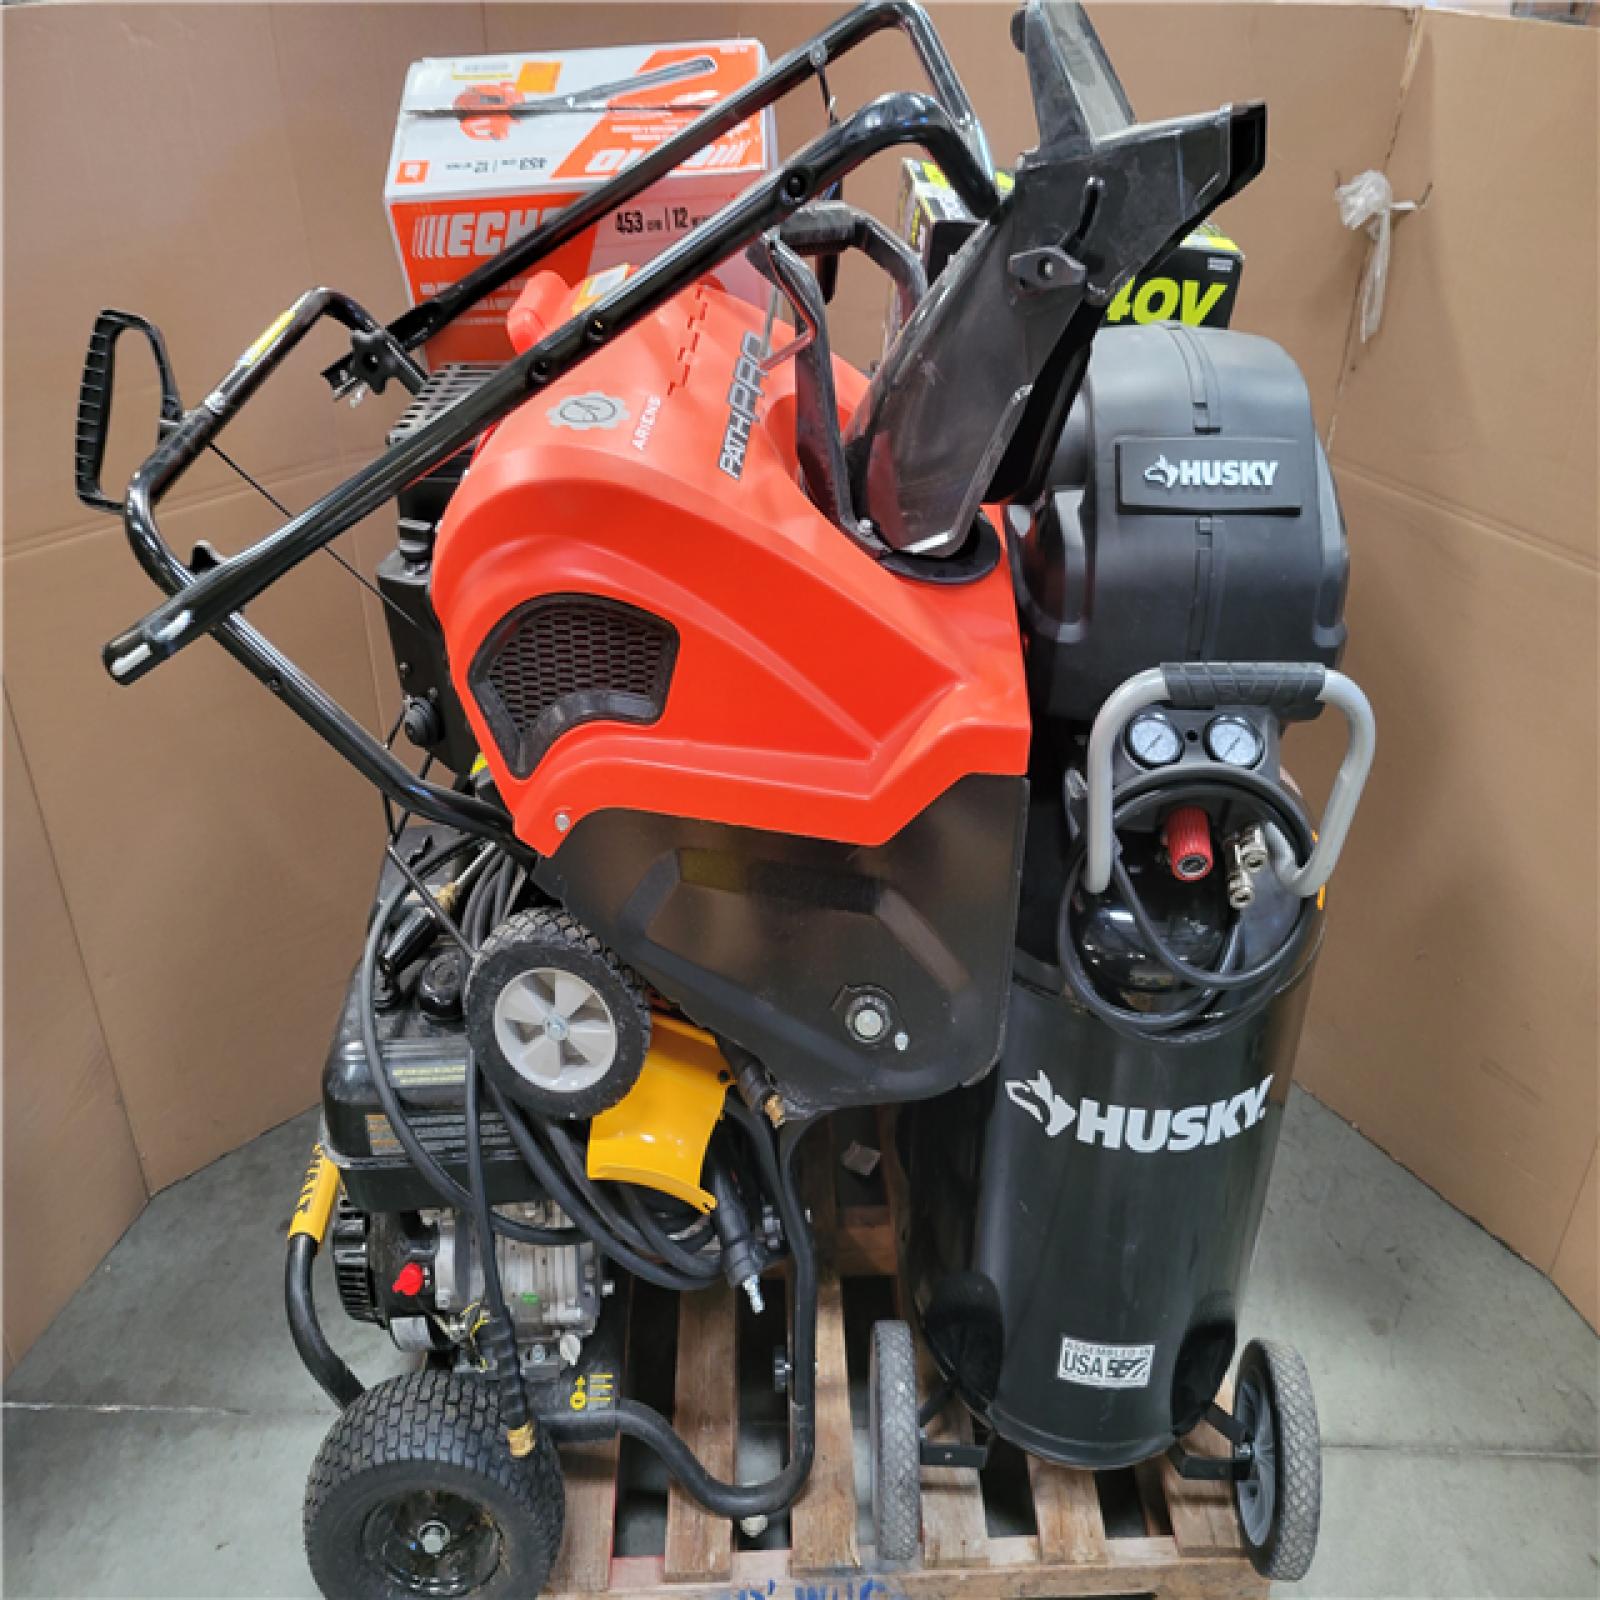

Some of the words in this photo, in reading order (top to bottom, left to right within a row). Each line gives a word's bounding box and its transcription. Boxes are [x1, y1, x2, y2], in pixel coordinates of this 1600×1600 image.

[447, 207, 566, 256] ECH
[615, 210, 643, 234] 453
[1179, 459, 1279, 486] HUSKY
[1076, 1073, 1274, 1153] HUSKY
[1064, 1350, 1102, 1377] USA
